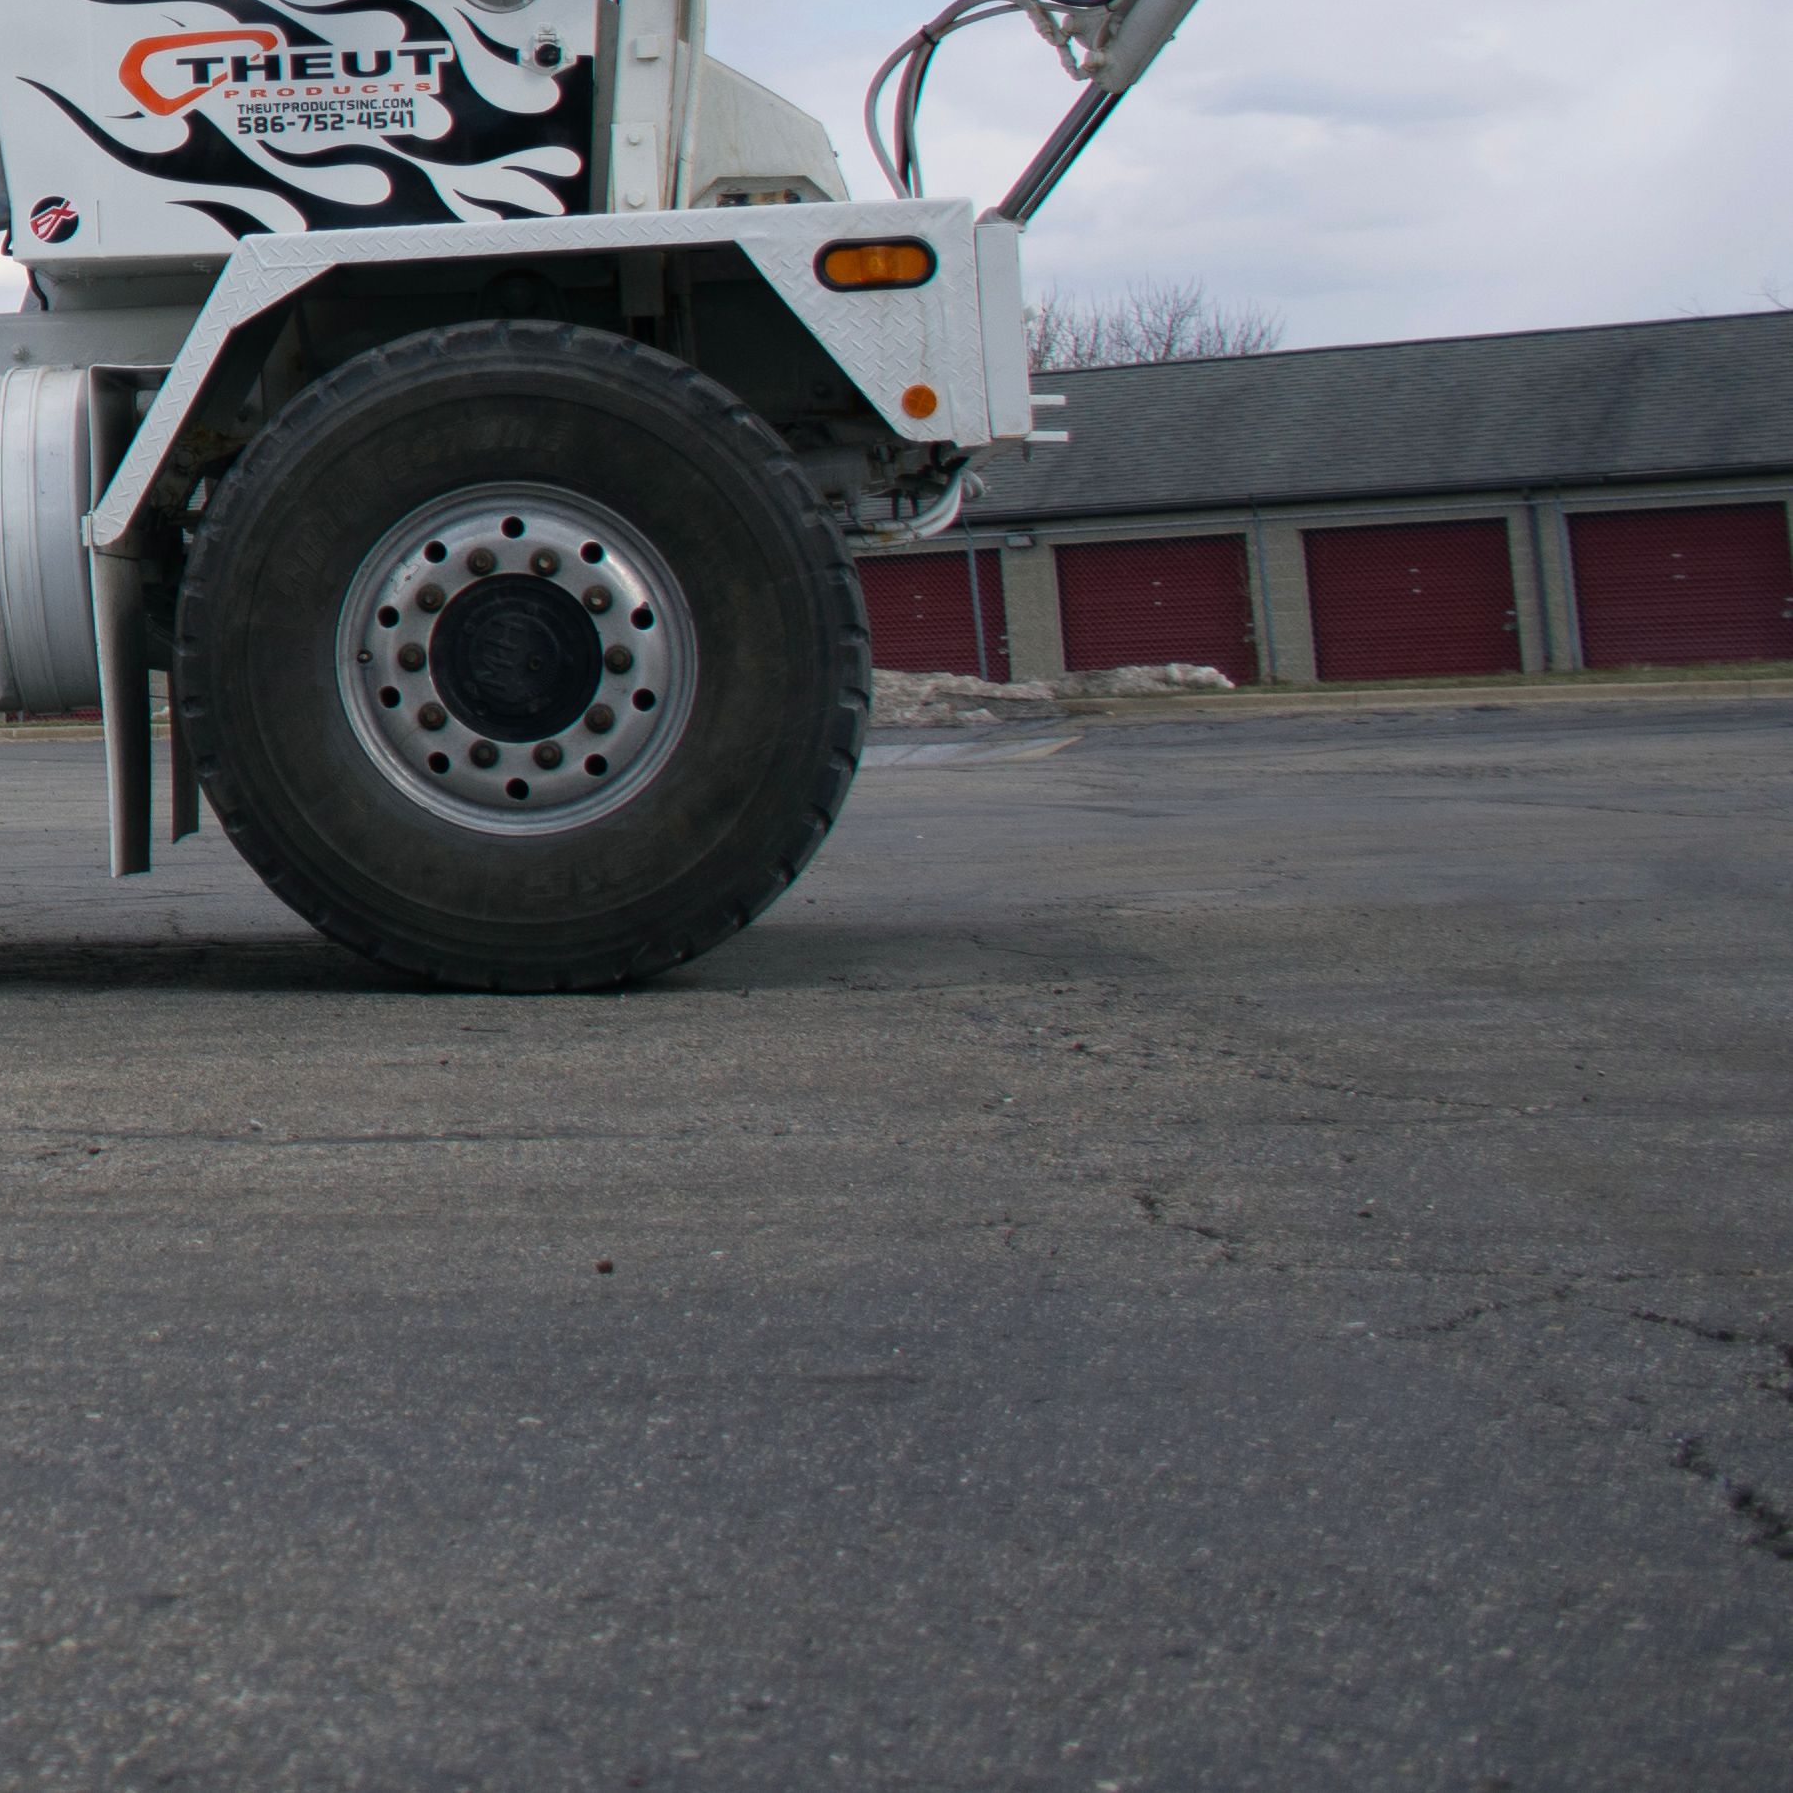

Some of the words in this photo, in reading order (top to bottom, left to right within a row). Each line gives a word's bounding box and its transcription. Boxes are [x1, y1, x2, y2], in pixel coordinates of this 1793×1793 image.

[175, 47, 446, 85] THEUT
[224, 82, 431, 99] PRODUCTS
[237, 98, 413, 114] THEUTPRODUCTSINC.COM
[238, 111, 415, 135] 586-752-4541
